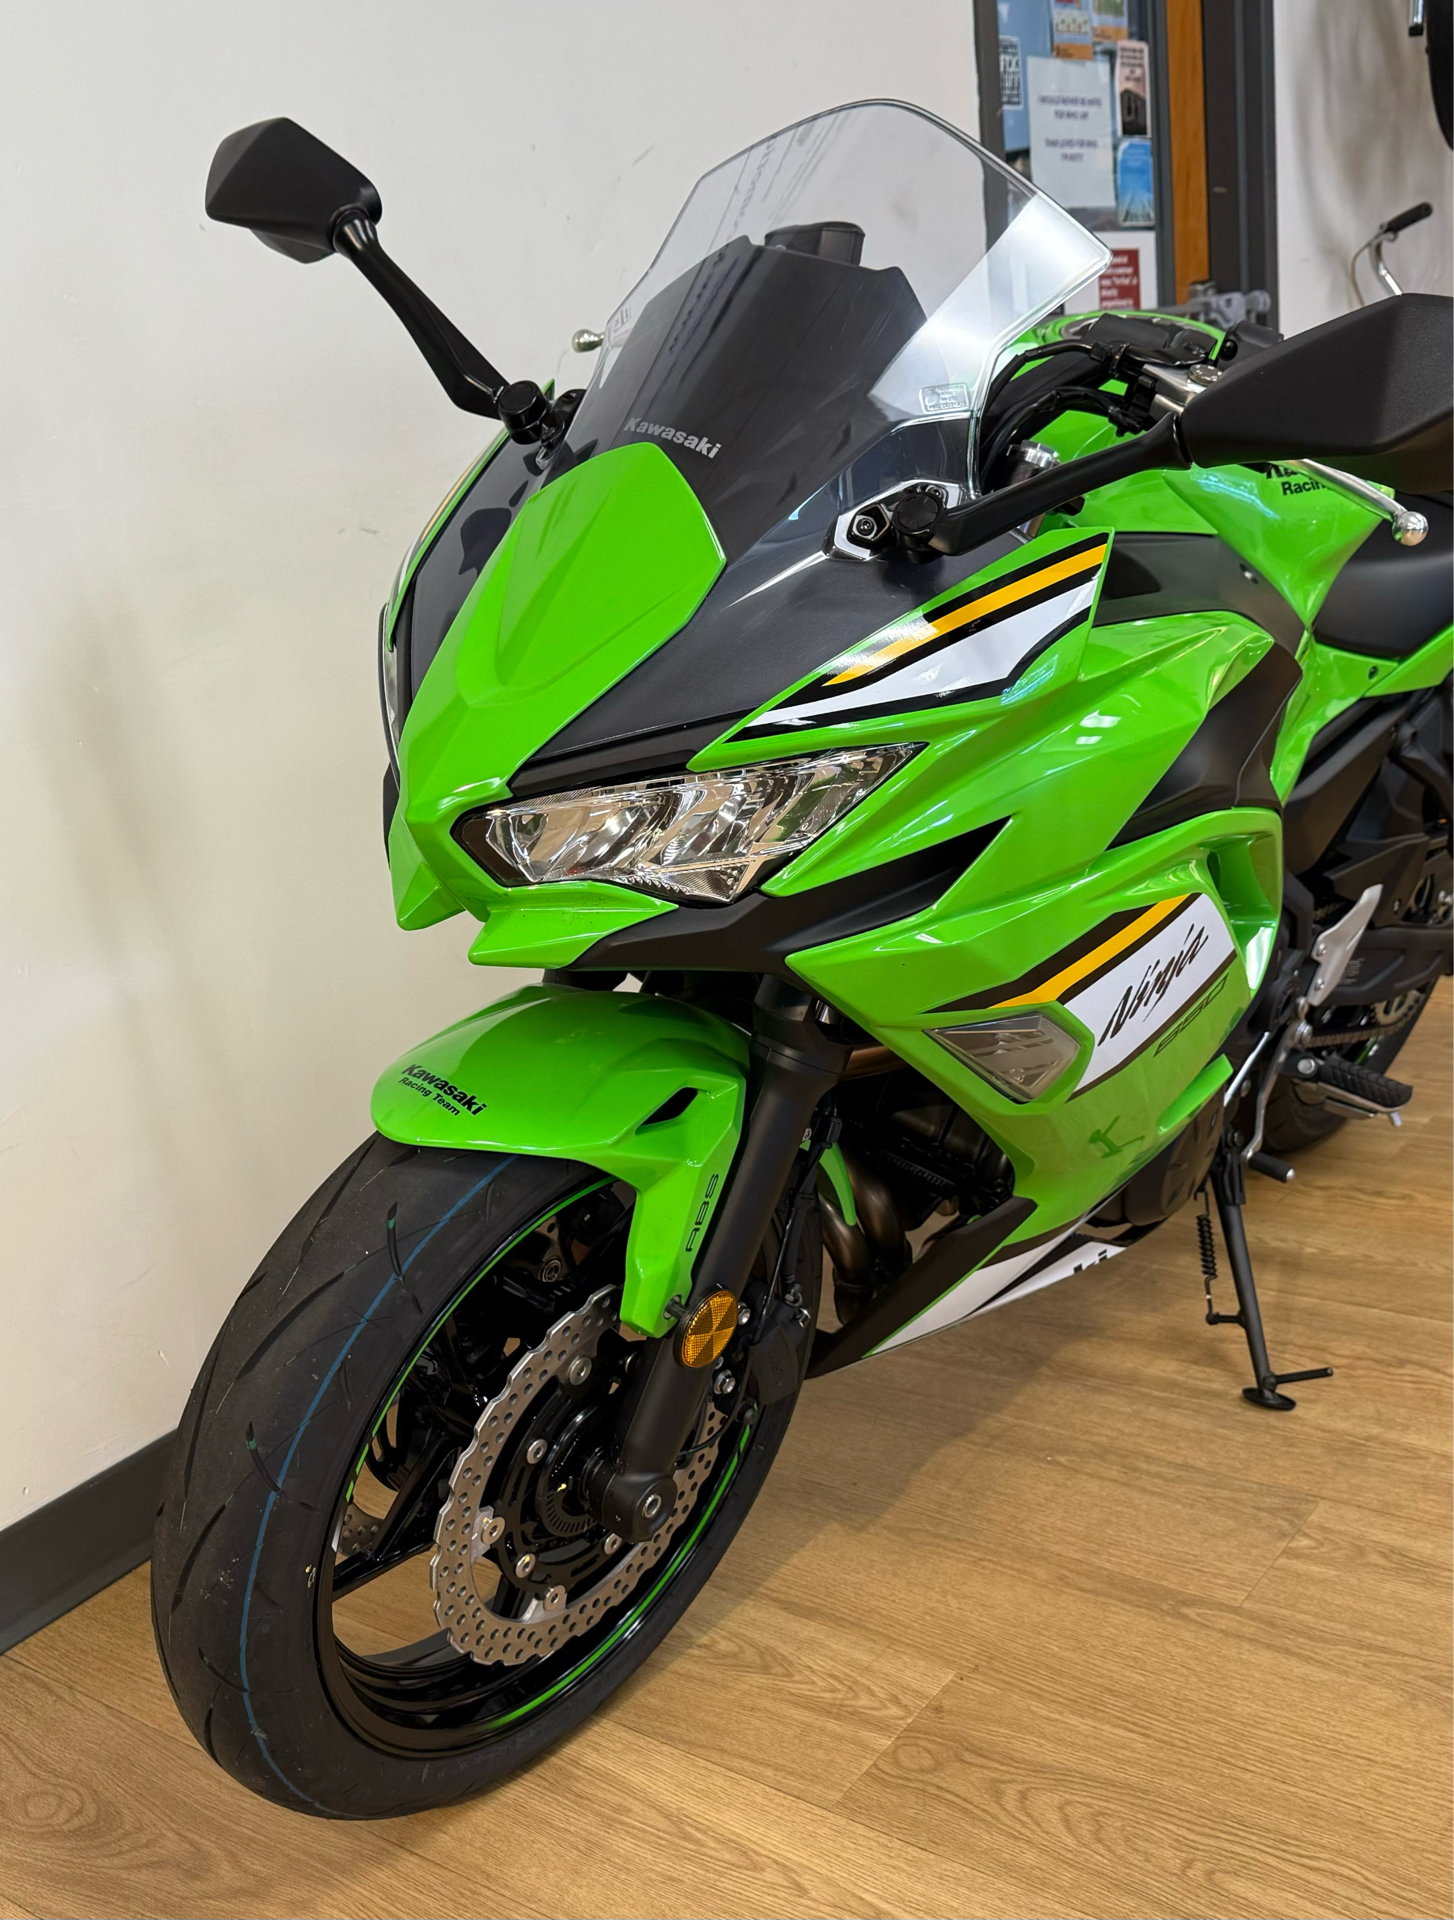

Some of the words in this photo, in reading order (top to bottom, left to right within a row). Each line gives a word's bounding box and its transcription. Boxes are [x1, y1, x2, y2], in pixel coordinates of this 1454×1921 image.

[623, 417, 722, 459] Kawasaki
[1281, 481, 1326, 497] Racin
[1098, 923, 1209, 1047] Ninja
[1153, 972, 1229, 1058] 650
[398, 1077, 432, 1098] Racing
[432, 1093, 461, 1116] Team
[402, 1063, 488, 1116] Kawasaki
[685, 1173, 719, 1252] ABS
